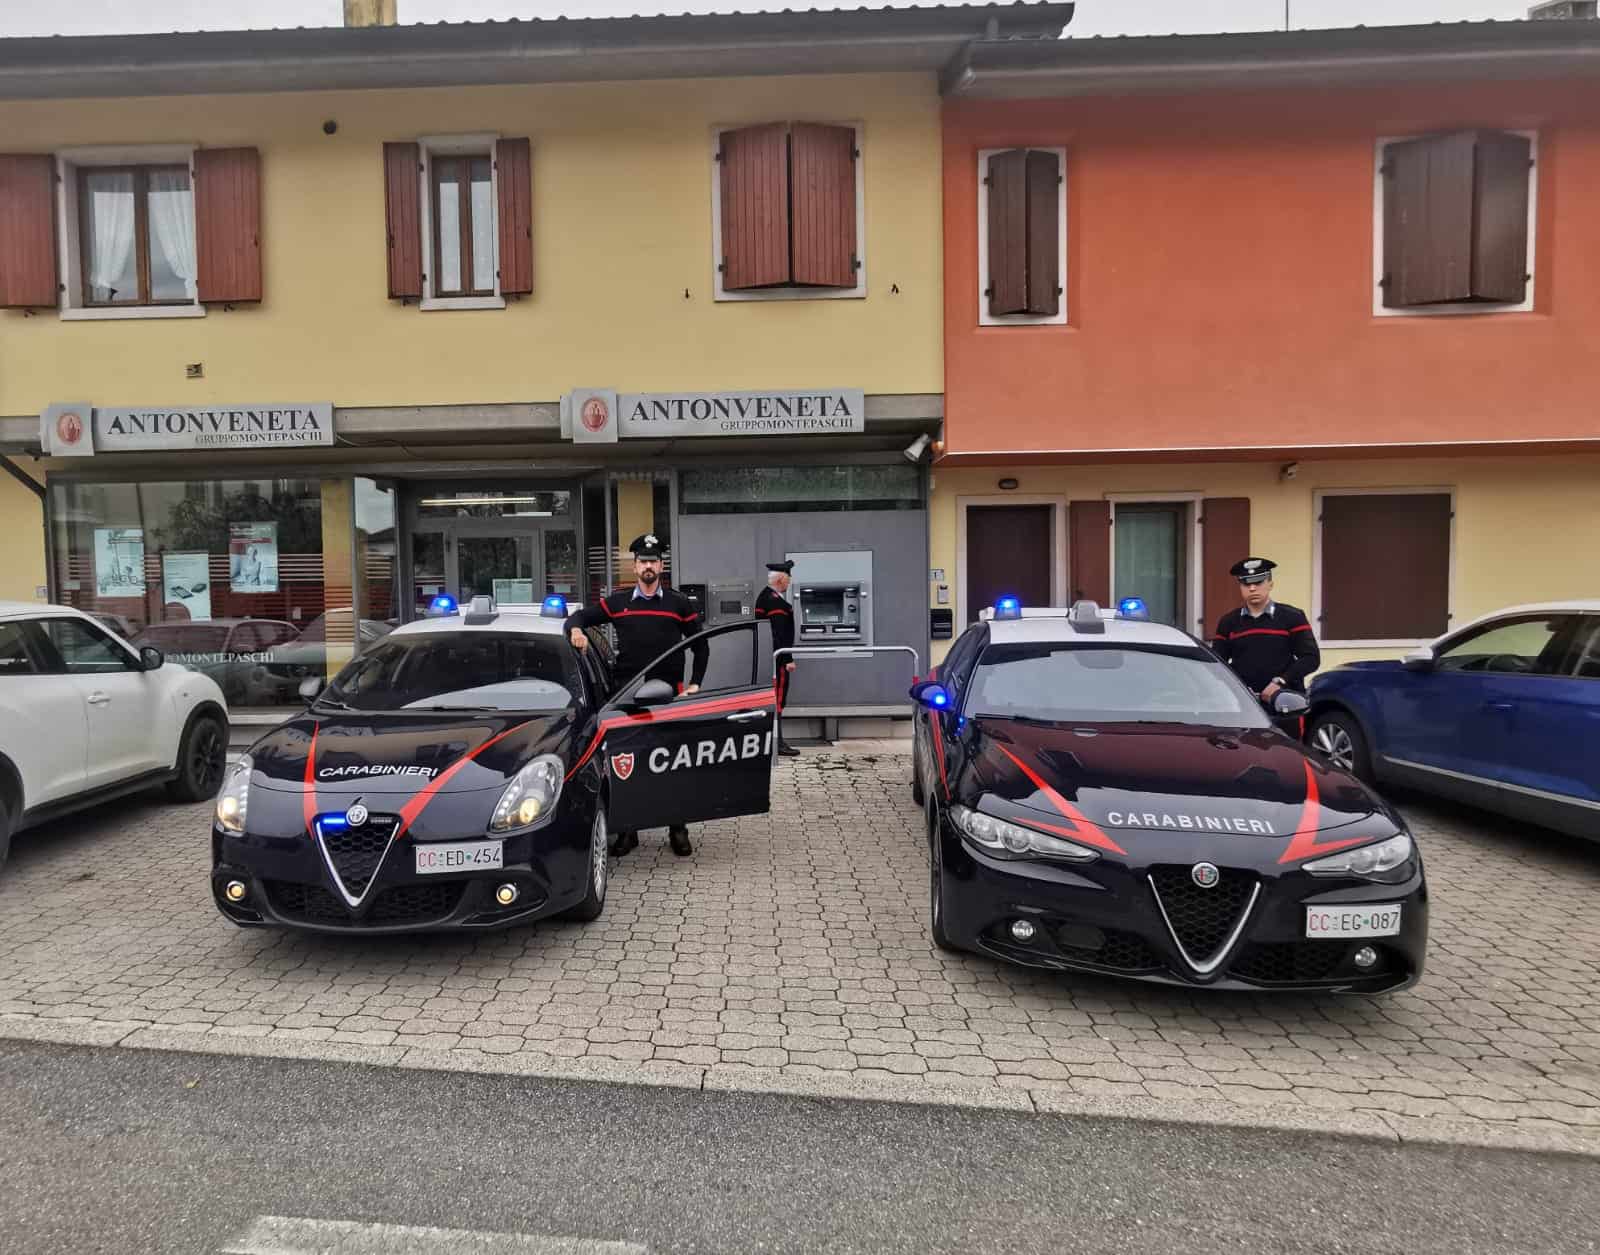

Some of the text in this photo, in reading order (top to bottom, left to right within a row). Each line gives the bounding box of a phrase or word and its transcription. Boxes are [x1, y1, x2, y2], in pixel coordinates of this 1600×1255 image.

[631, 396, 851, 420] ANTONVENETA
[108, 410, 320, 434] ANTONVENETA
[647, 731, 773, 774] CARABI
[319, 765, 438, 777] CARABINIERI
[1107, 811, 1276, 834] CARABINIERI
